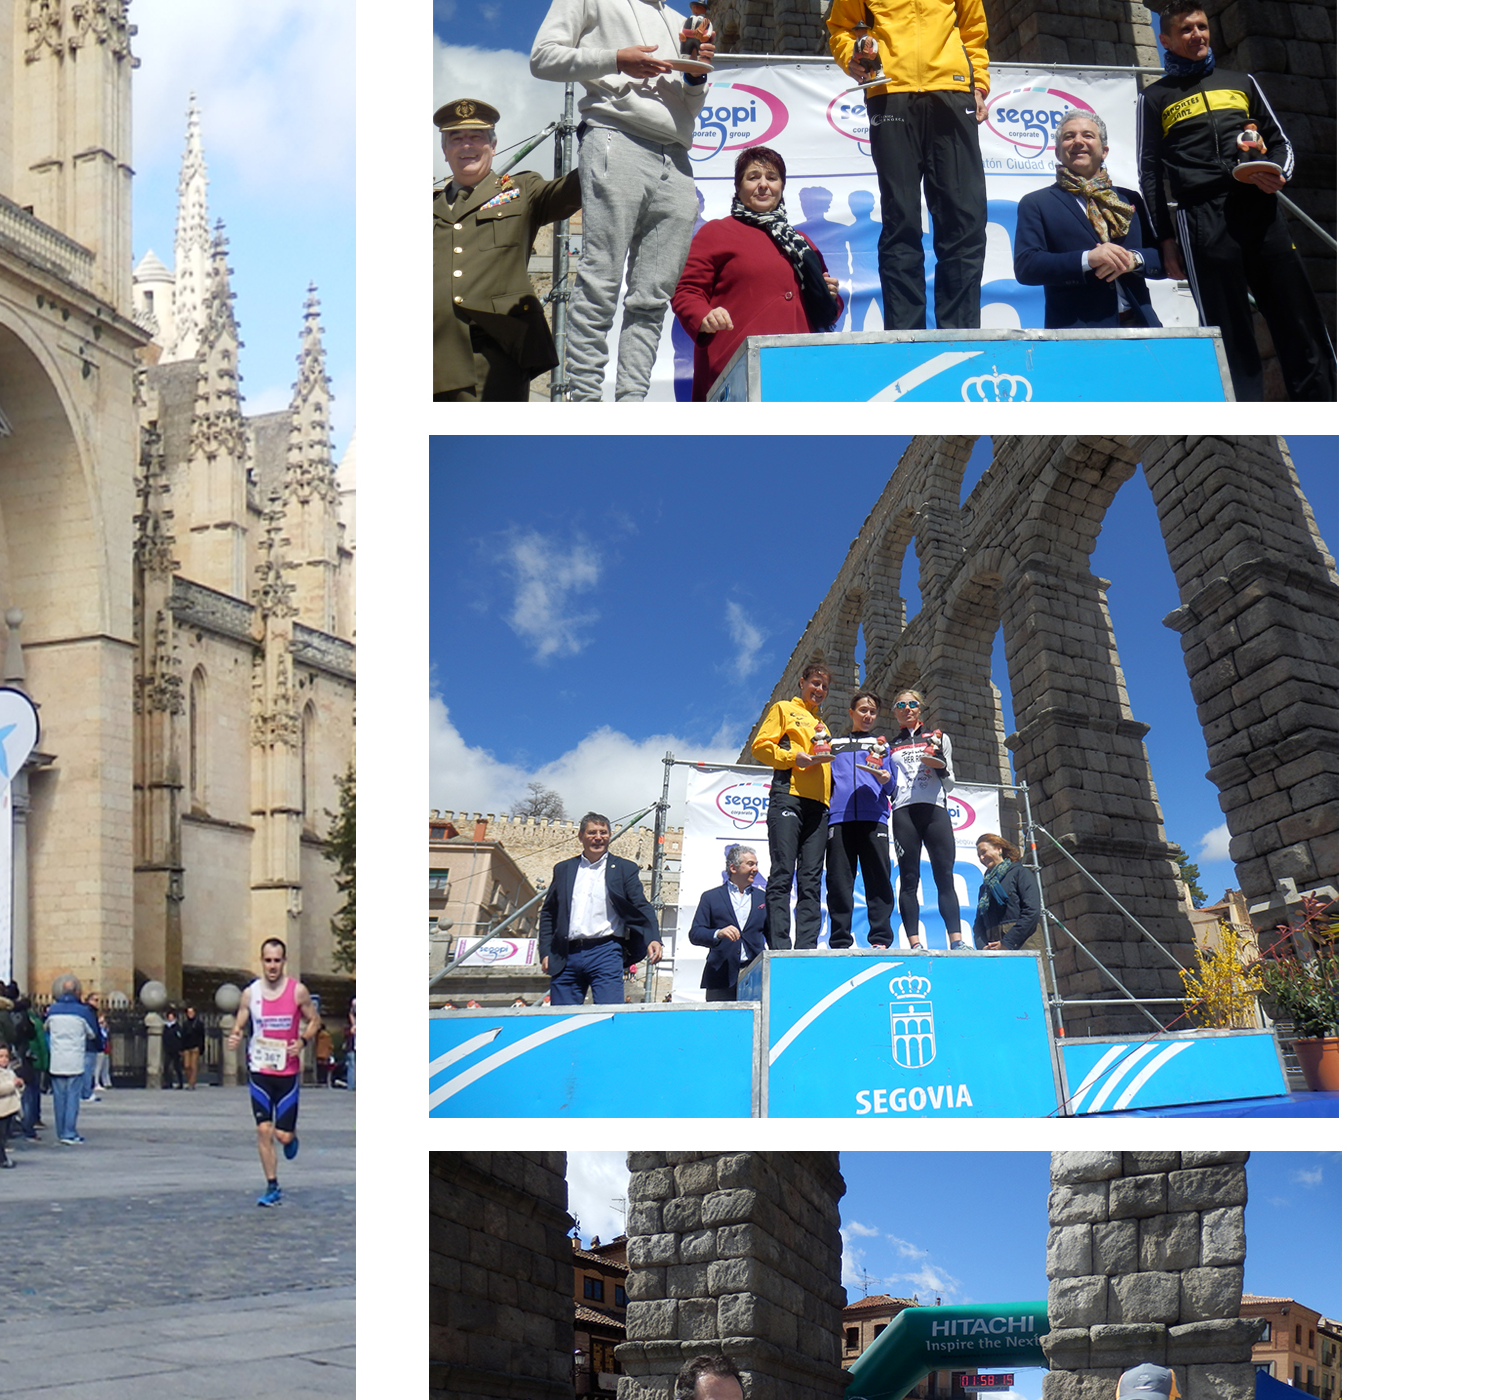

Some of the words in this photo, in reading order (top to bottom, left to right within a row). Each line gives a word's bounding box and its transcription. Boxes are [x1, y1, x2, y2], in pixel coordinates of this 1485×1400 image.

[692, 130, 717, 139] porate
[1006, 157, 1046, 170] Ciudad
[855, 1084, 973, 1115] SEGOVIA
[932, 1316, 1034, 1337] HITACHI
[926, 1338, 974, 1353] Inspire
[979, 1337, 1001, 1349] the
[961, 1374, 1013, 1387] 01:58:15
